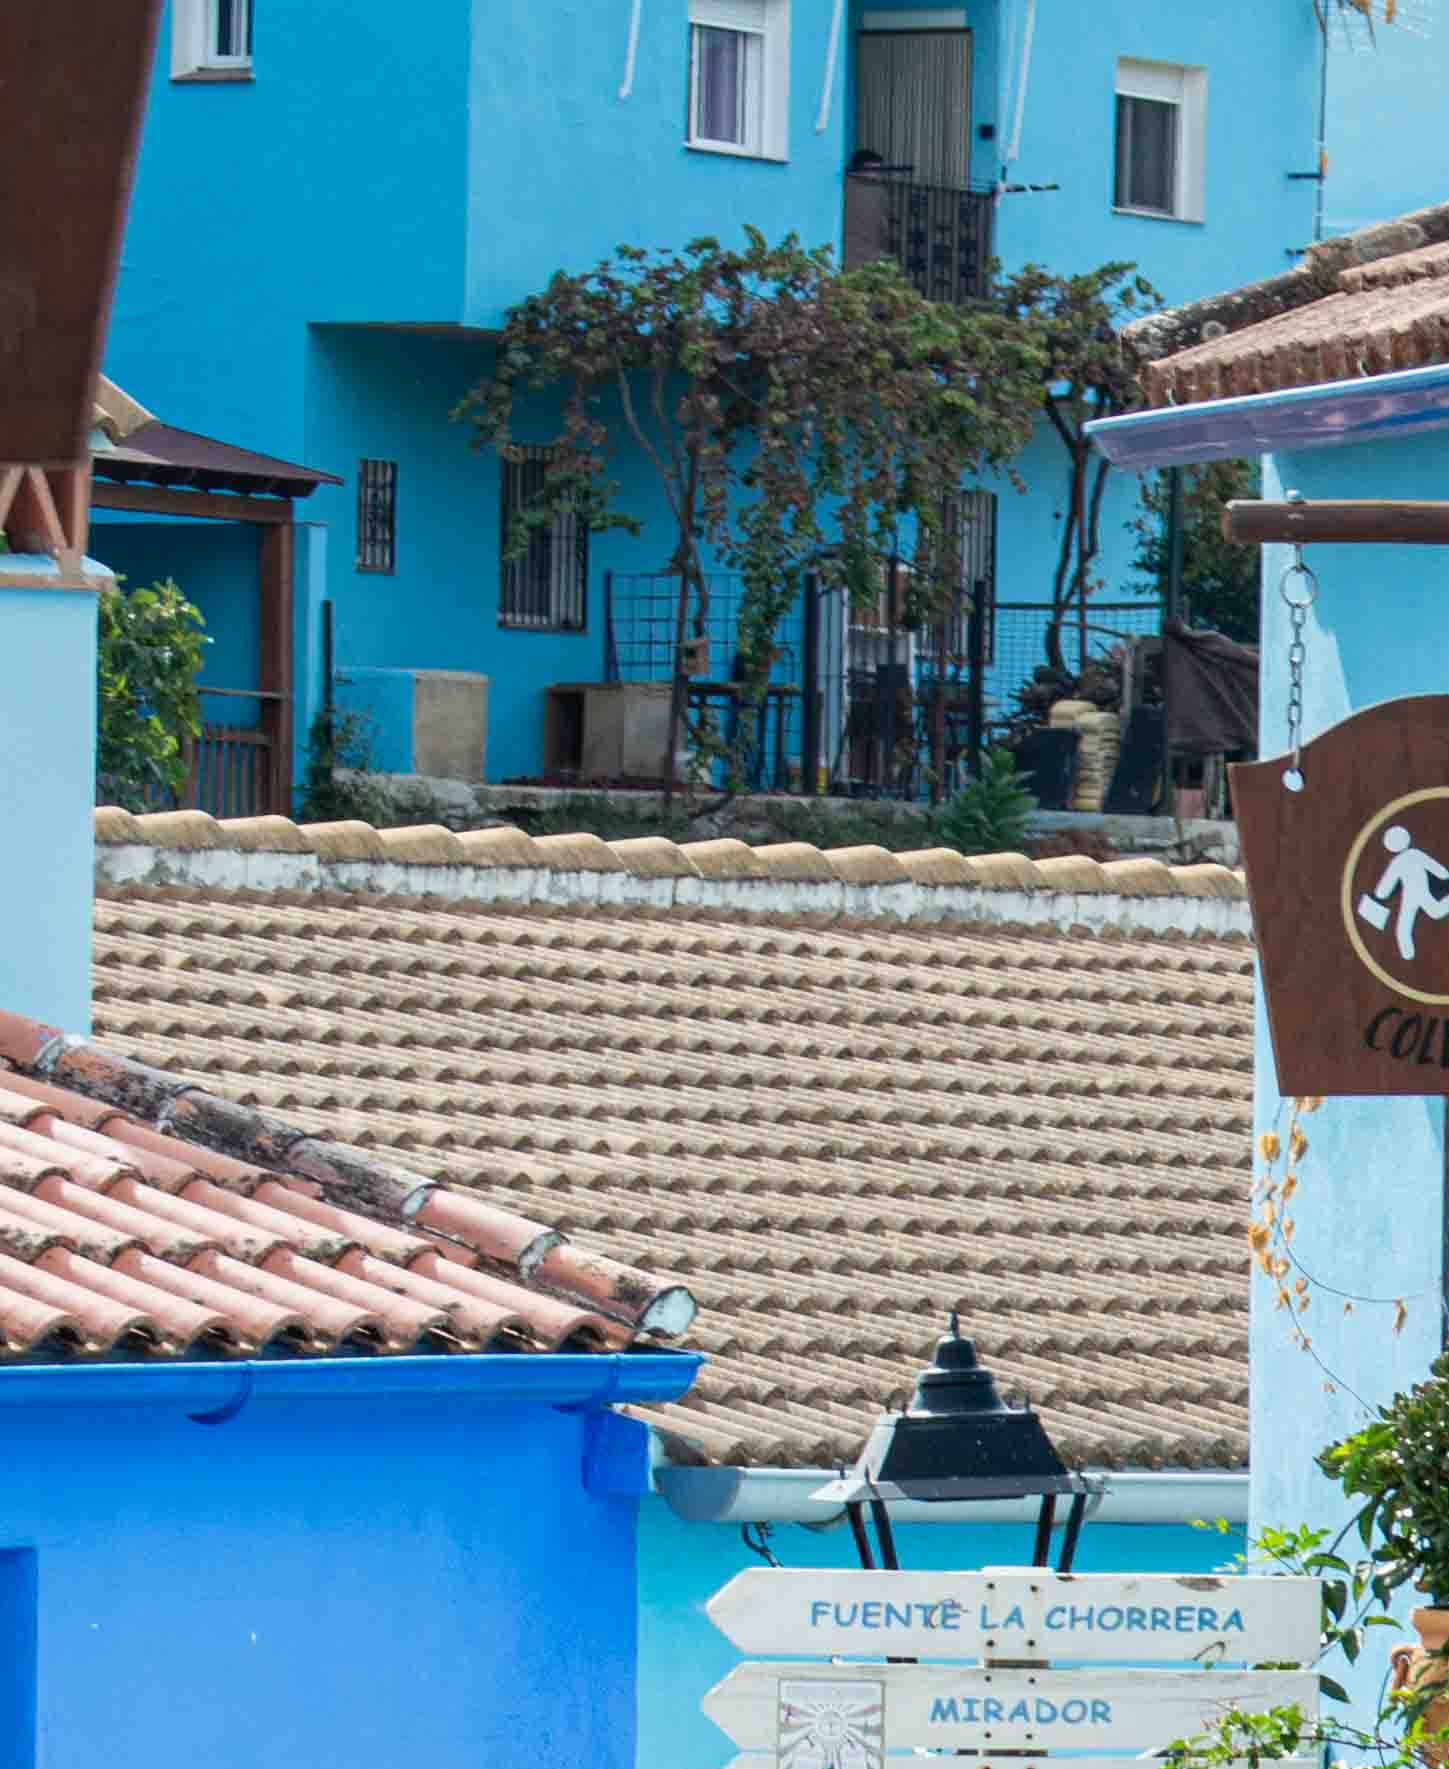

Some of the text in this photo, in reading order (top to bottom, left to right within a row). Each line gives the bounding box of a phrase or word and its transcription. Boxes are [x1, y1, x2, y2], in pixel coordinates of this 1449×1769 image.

[809, 1601, 1247, 1633] FUENTE LA CHORRERA
[929, 1697, 1112, 1724] MIRADOR
